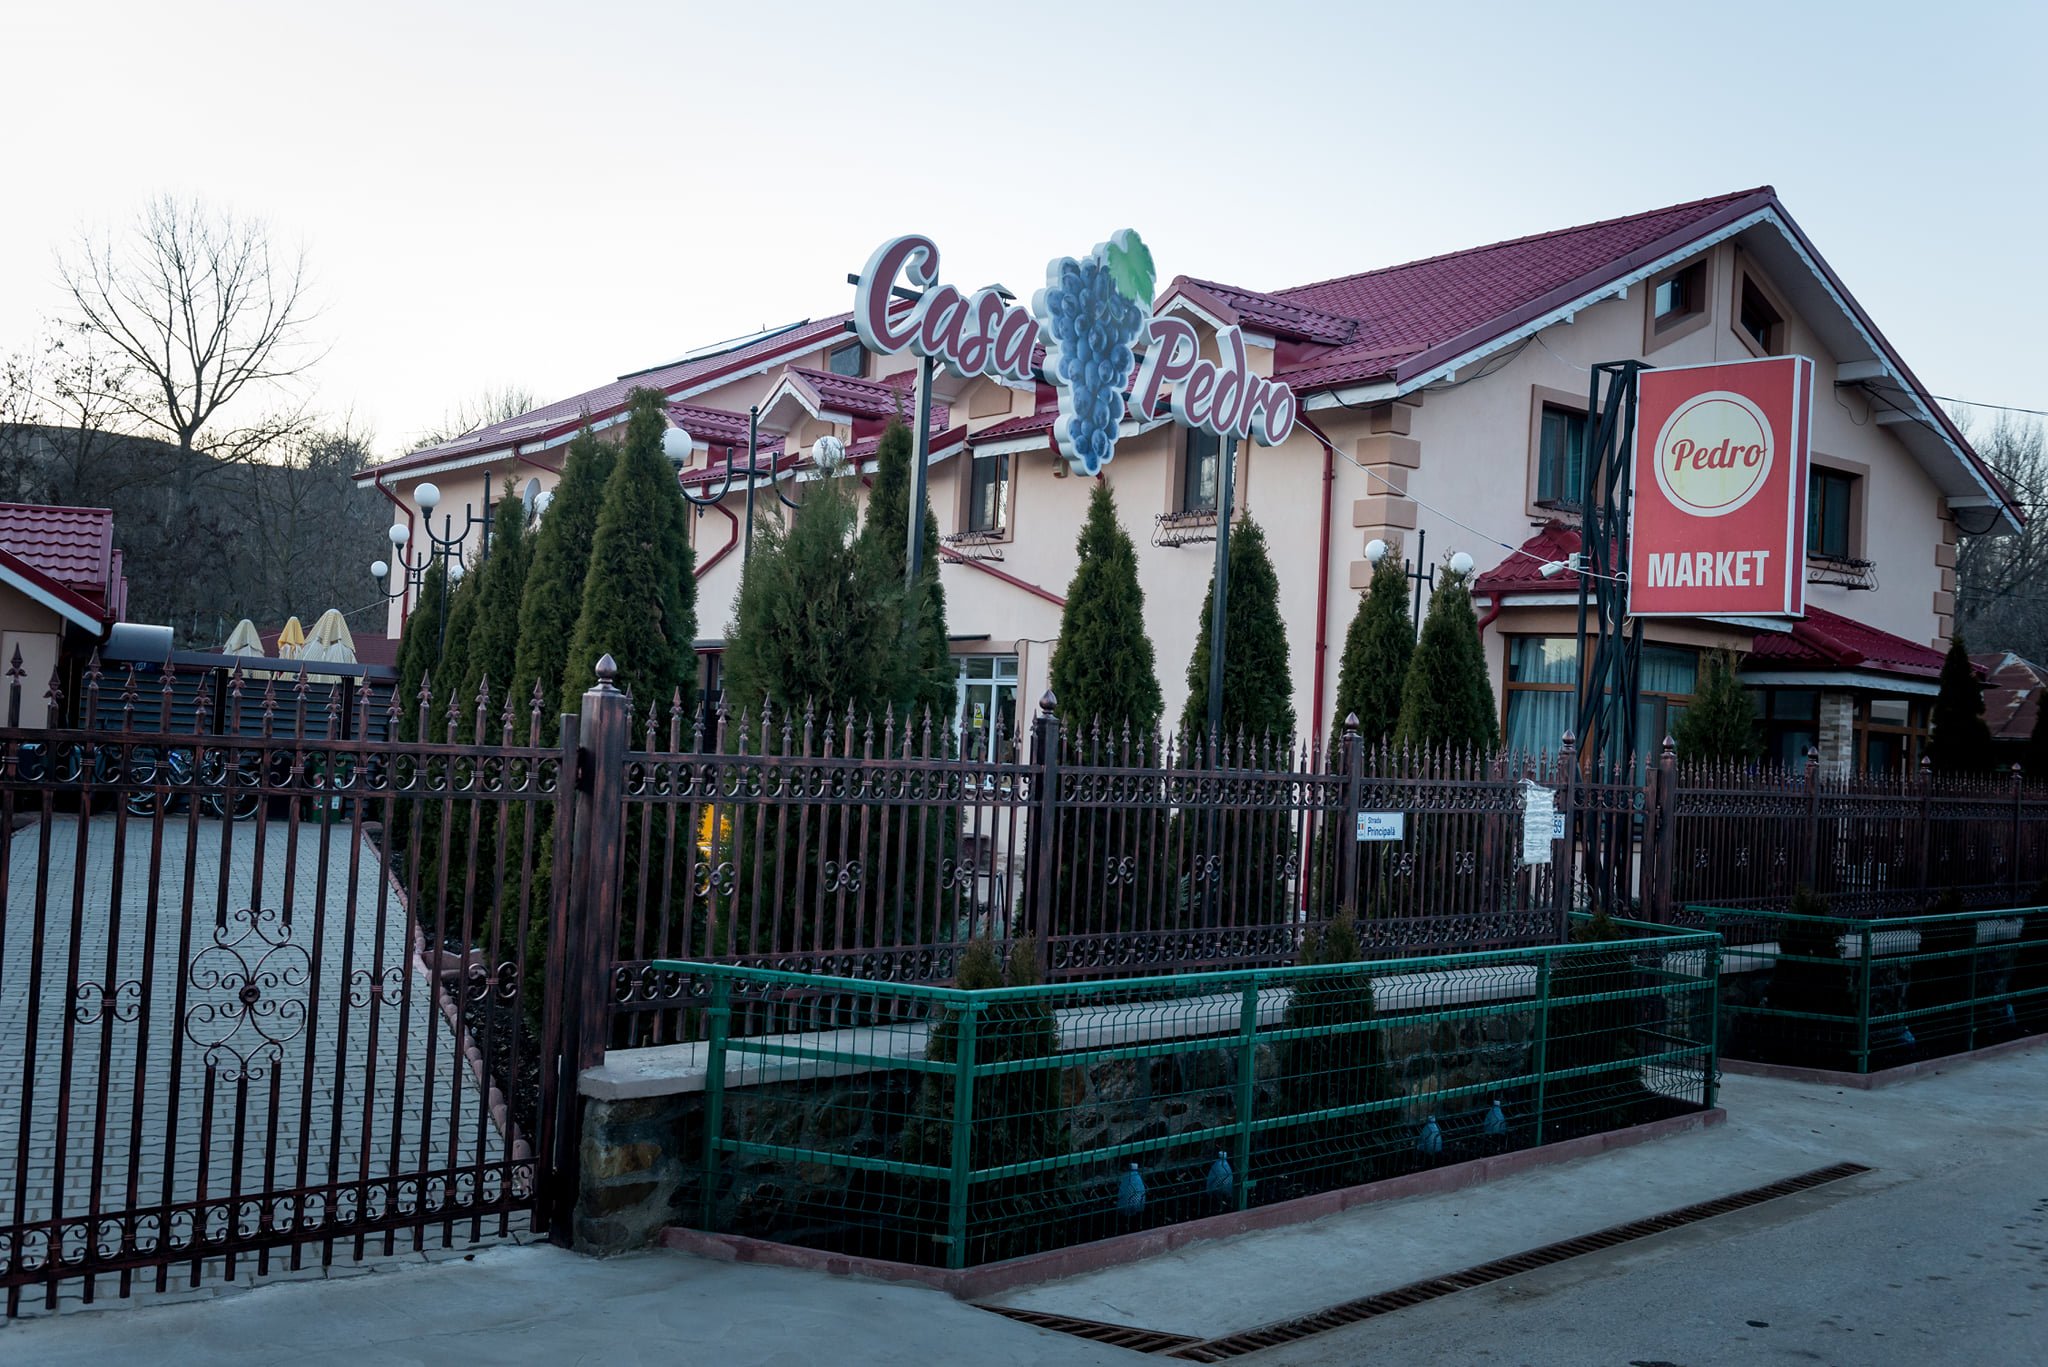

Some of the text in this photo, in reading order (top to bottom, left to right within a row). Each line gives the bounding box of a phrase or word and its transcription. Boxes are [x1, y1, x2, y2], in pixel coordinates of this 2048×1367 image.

[857, 235, 1297, 447] Casa Pedro
[1671, 438, 1768, 471] Pedro
[1647, 550, 1770, 588] MARKET
[1367, 816, 1382, 824] Strada
